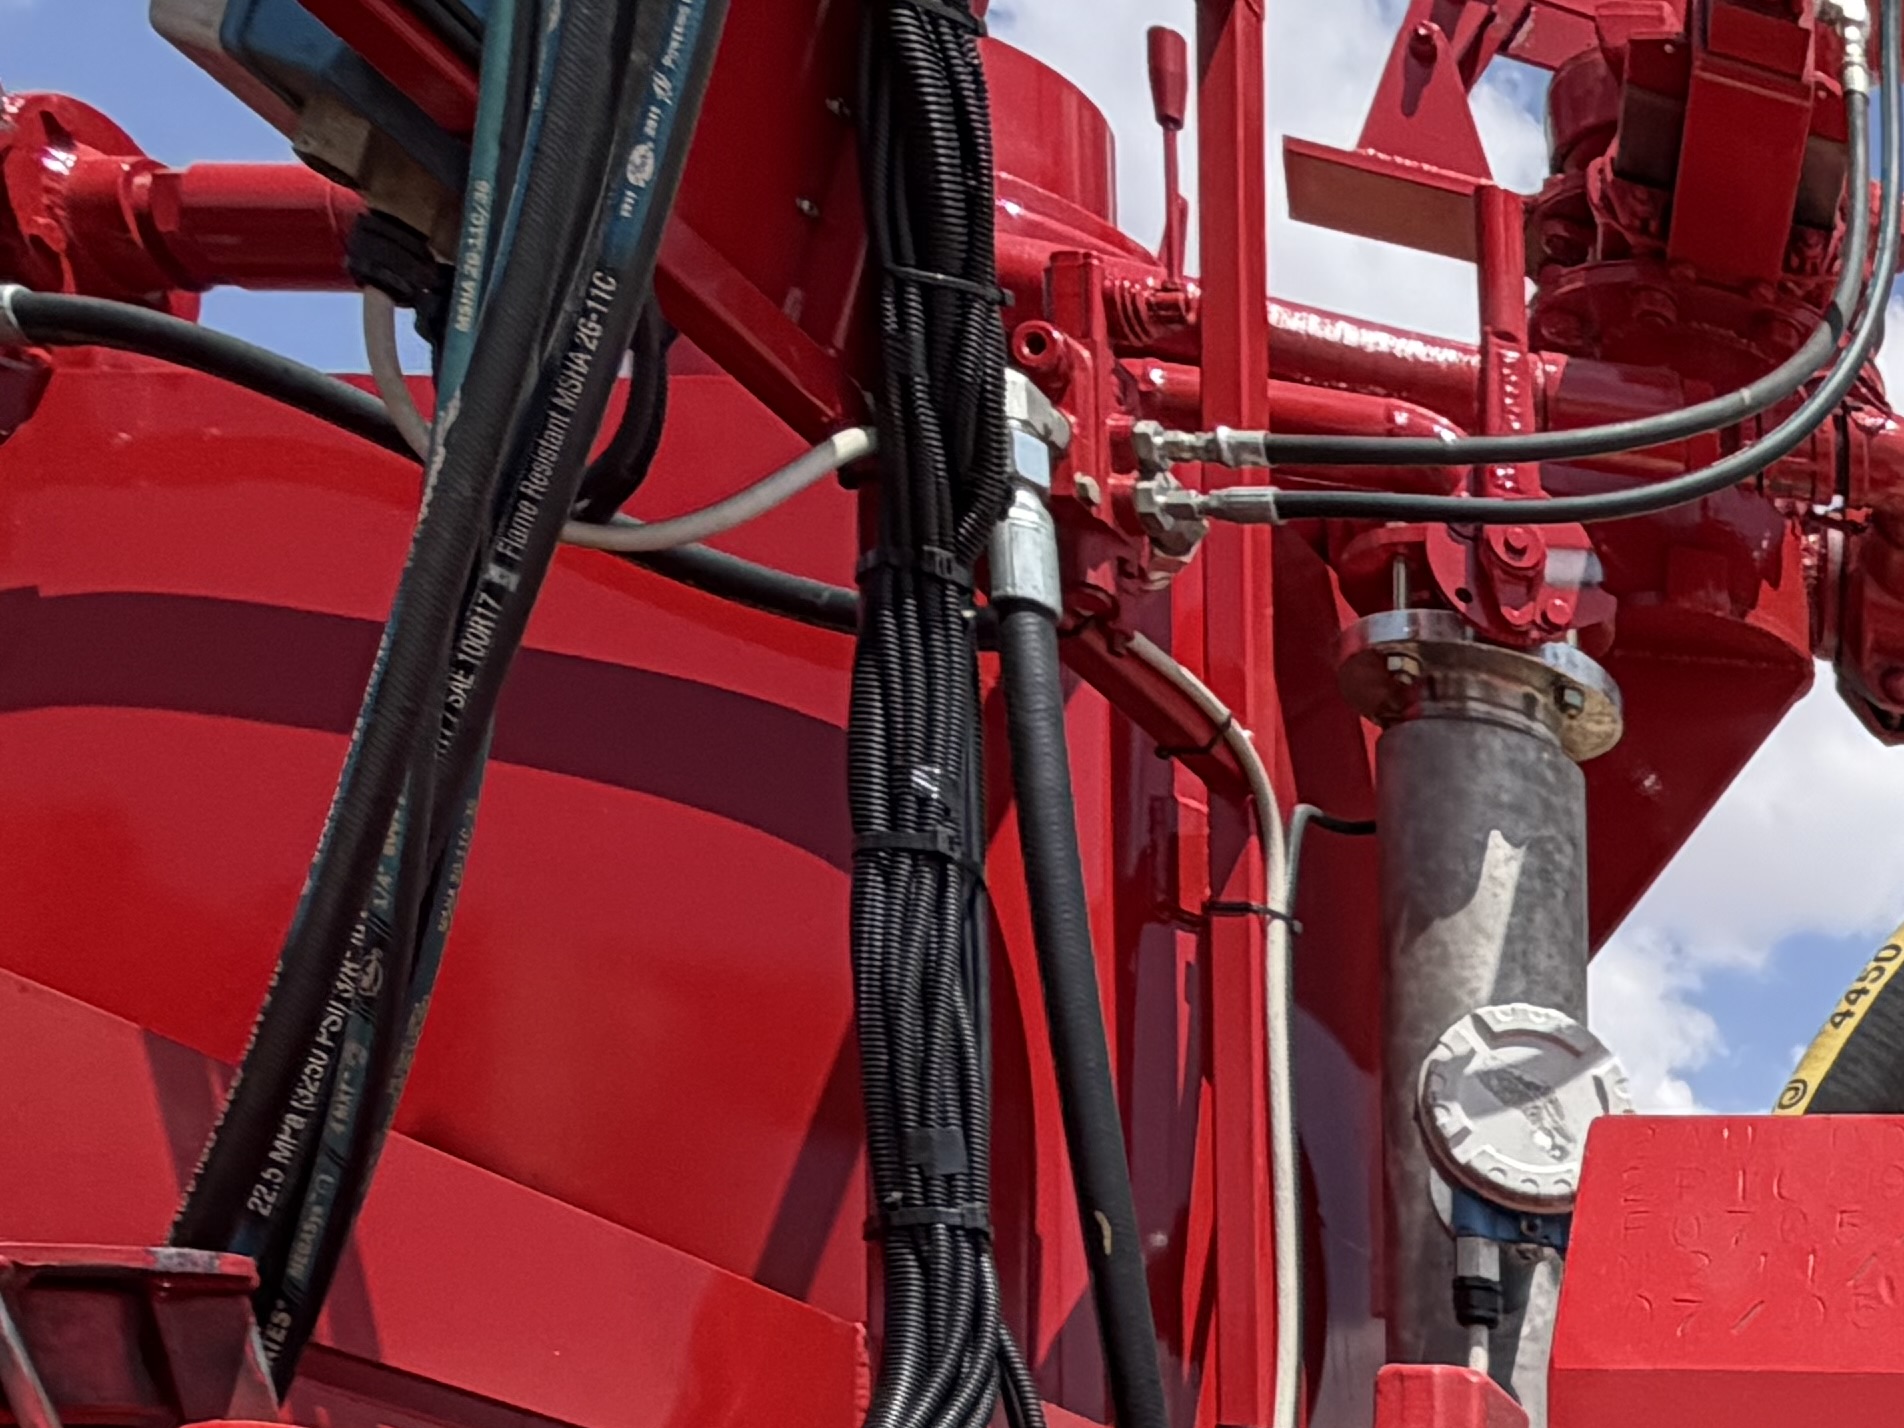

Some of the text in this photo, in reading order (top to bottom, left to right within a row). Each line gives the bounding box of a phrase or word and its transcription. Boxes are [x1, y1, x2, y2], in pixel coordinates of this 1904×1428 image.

[497, 500, 540, 561] Flame
[519, 408, 570, 501] Resistant
[552, 350, 592, 411] MSHA
[574, 270, 617, 351] 2G-11C
[1829, 943, 1902, 1029] 4450
